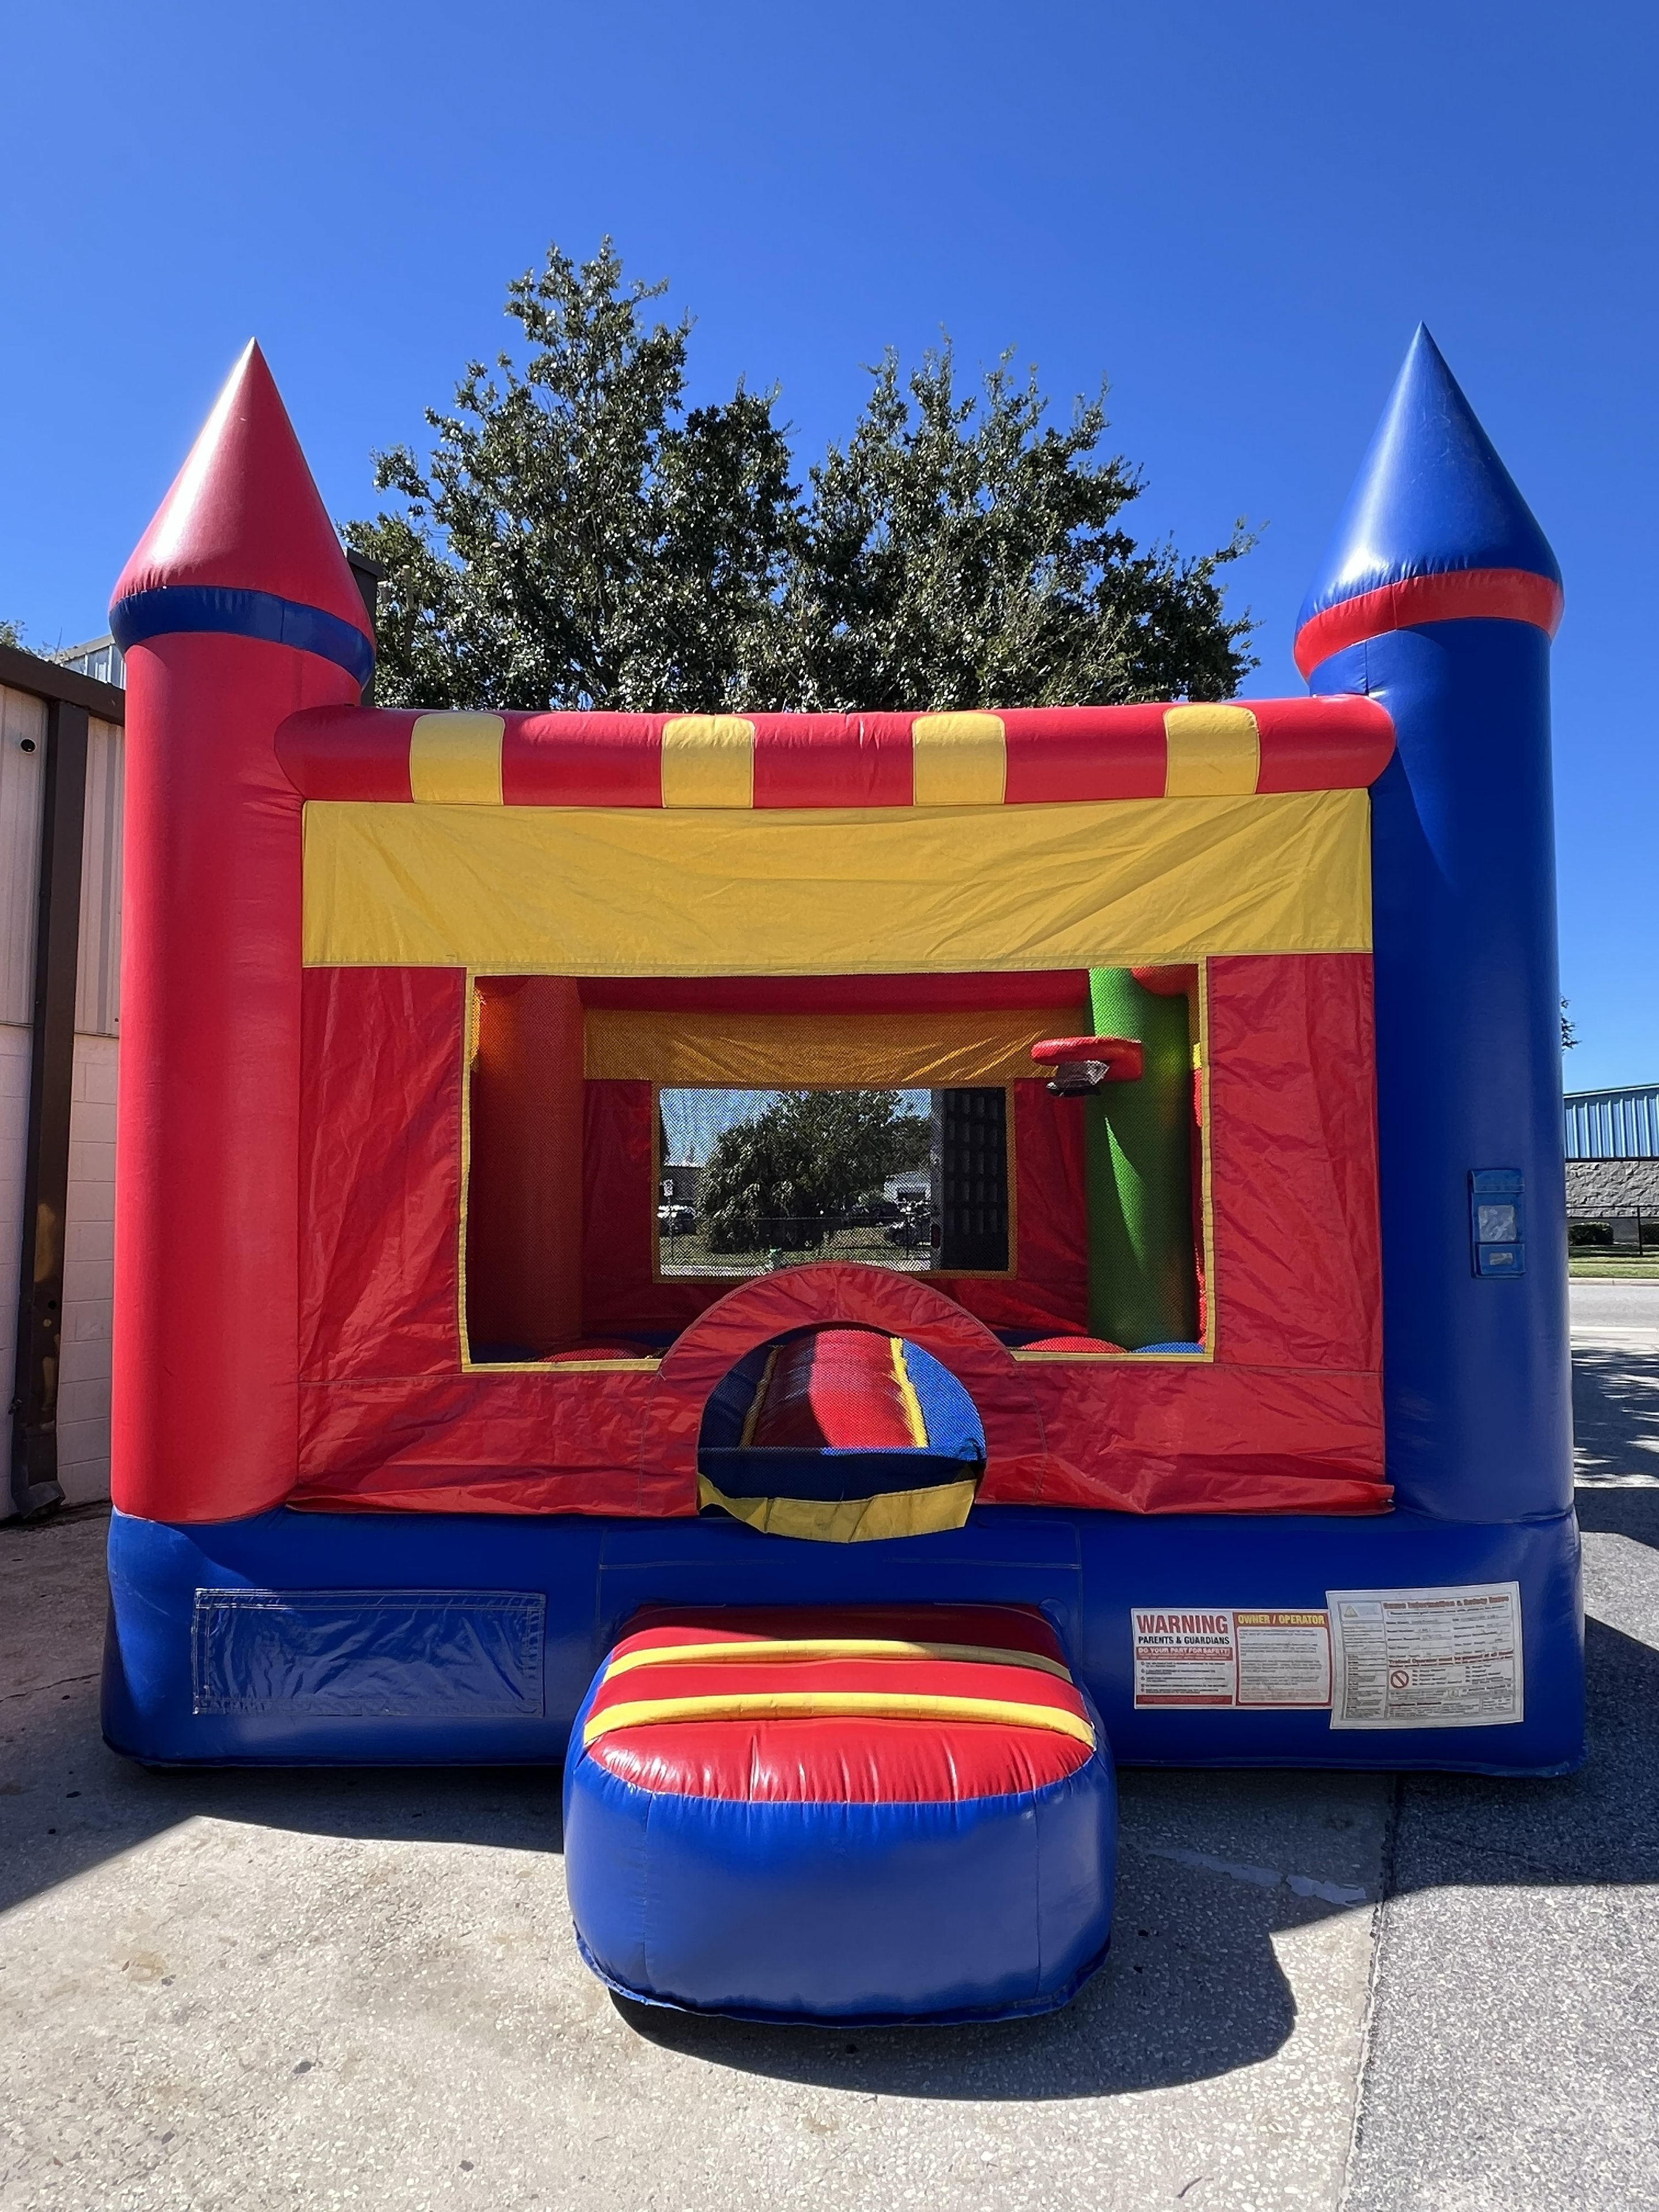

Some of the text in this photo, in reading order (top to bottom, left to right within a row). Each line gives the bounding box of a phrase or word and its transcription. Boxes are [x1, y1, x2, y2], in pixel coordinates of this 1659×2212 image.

[1238, 1614, 1325, 1624] OWNER / OPERATOR
[1136, 1615, 1229, 1634] WARNING
[1138, 1636, 1230, 1645] PARENTS & GUARDIANS
